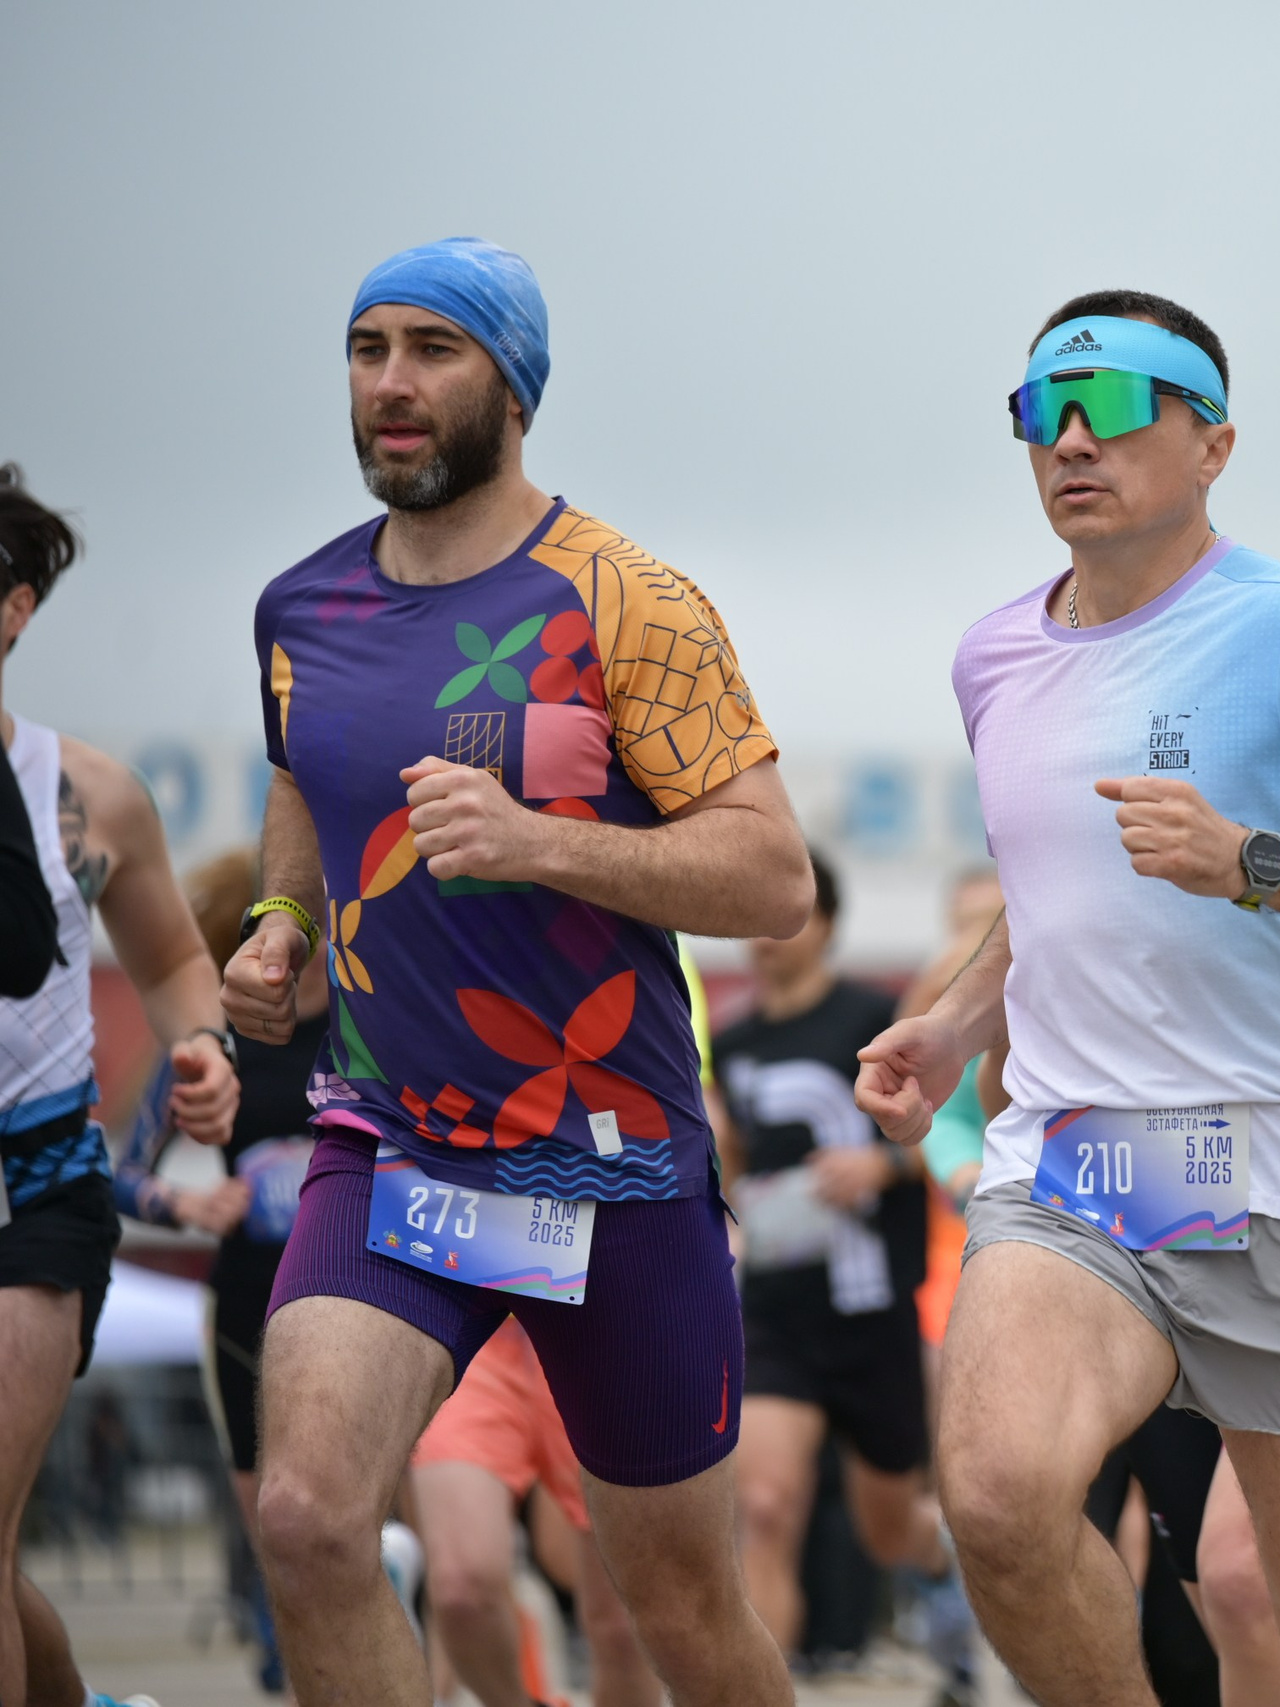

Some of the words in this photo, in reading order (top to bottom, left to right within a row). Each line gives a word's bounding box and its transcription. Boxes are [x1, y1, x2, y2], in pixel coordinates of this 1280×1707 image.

[1055, 341, 1102, 356] adidas
[1149, 731, 1184, 748] EVERY
[1146, 1117, 1198, 1132] ЭСТАФЕТА
[1185, 1136, 1195, 1159] 5
[1076, 1141, 1133, 1195] 210
[1185, 1161, 1232, 1184] 2025
[407, 1186, 480, 1239] 273
[532, 1197, 543, 1219] 5
[529, 1221, 575, 1247] 2025
